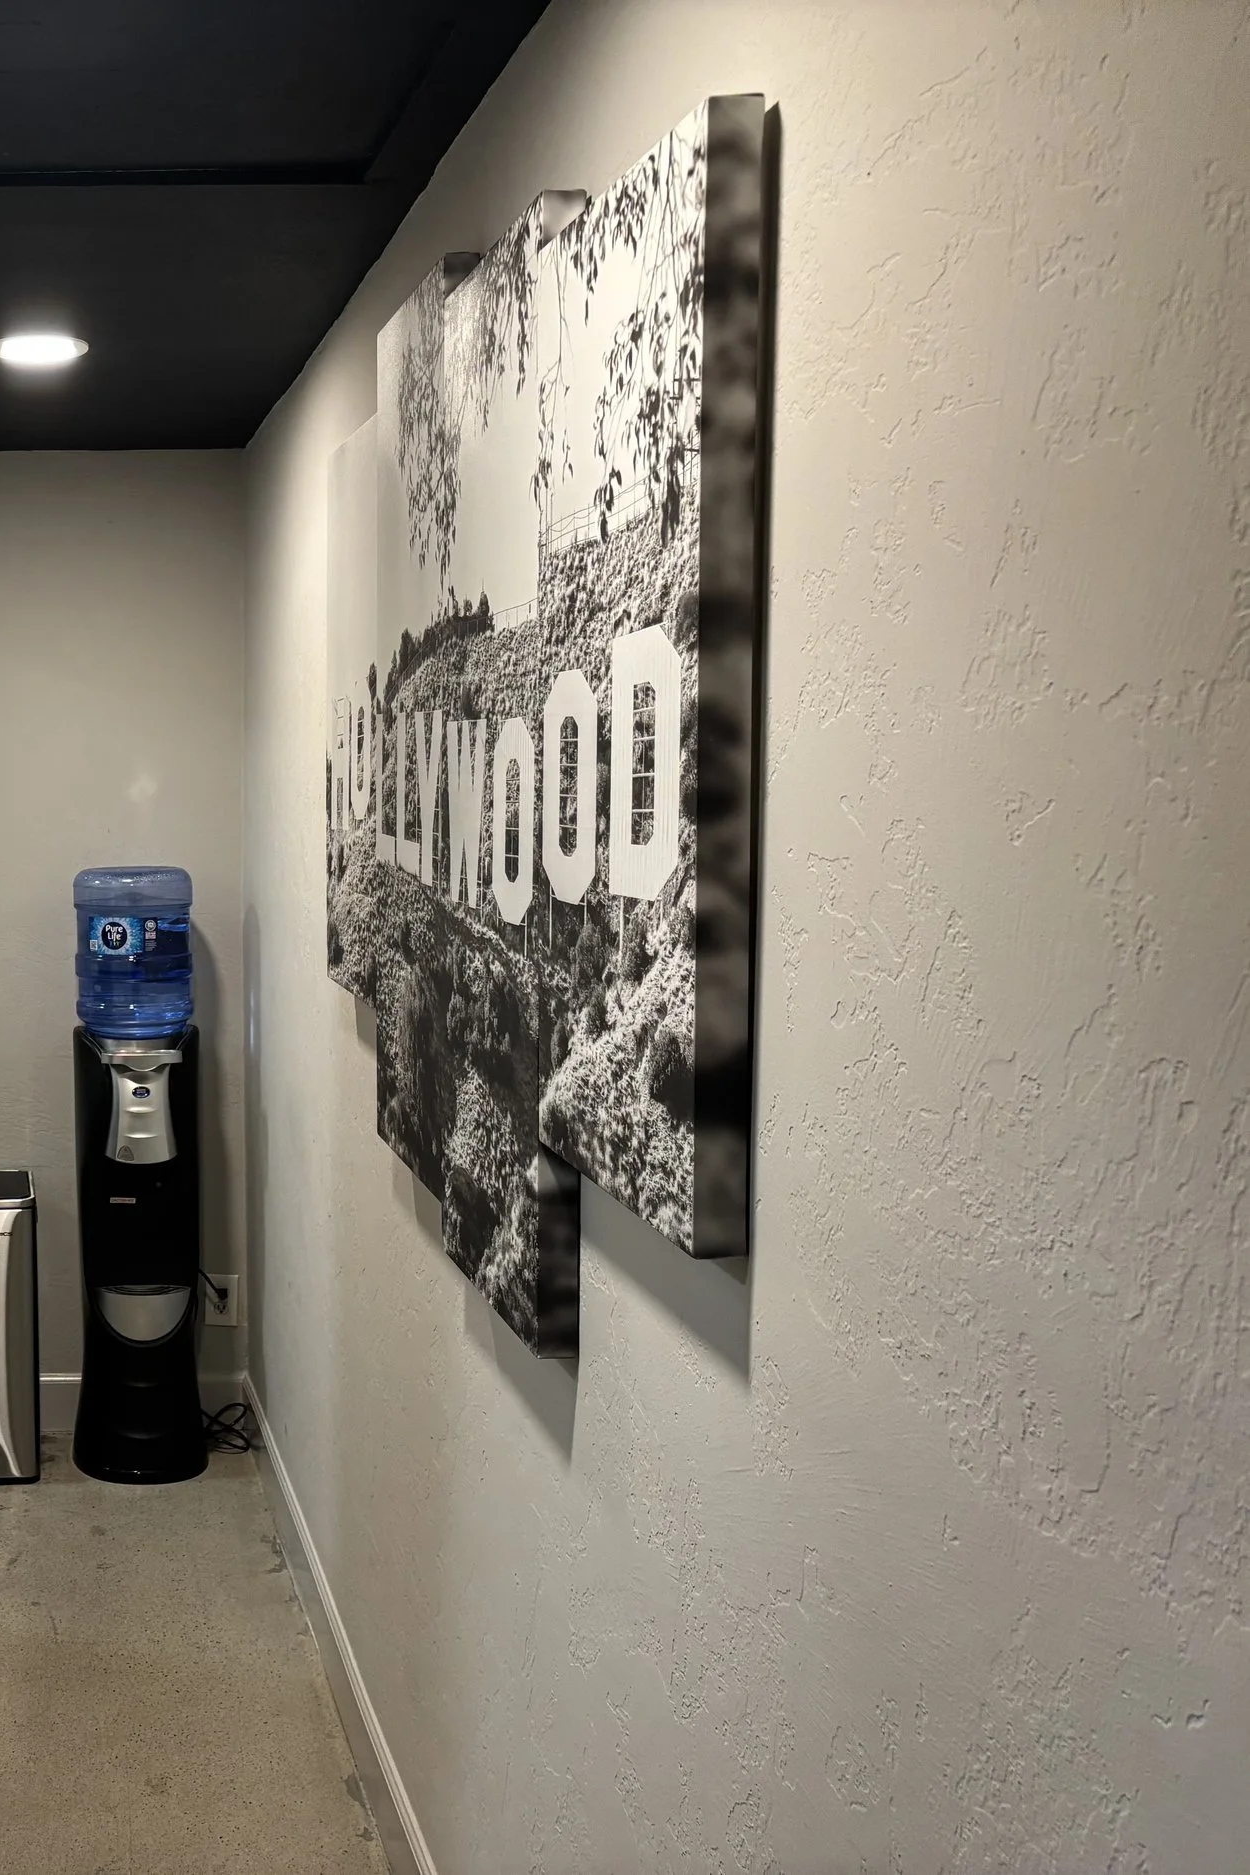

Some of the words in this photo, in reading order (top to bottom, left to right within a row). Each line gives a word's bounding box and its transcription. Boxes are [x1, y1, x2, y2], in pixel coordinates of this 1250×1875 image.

[330, 623, 682, 926] HOLLYWOOD
[105, 924, 123, 932] Pure
[107, 932, 121, 941] Life
